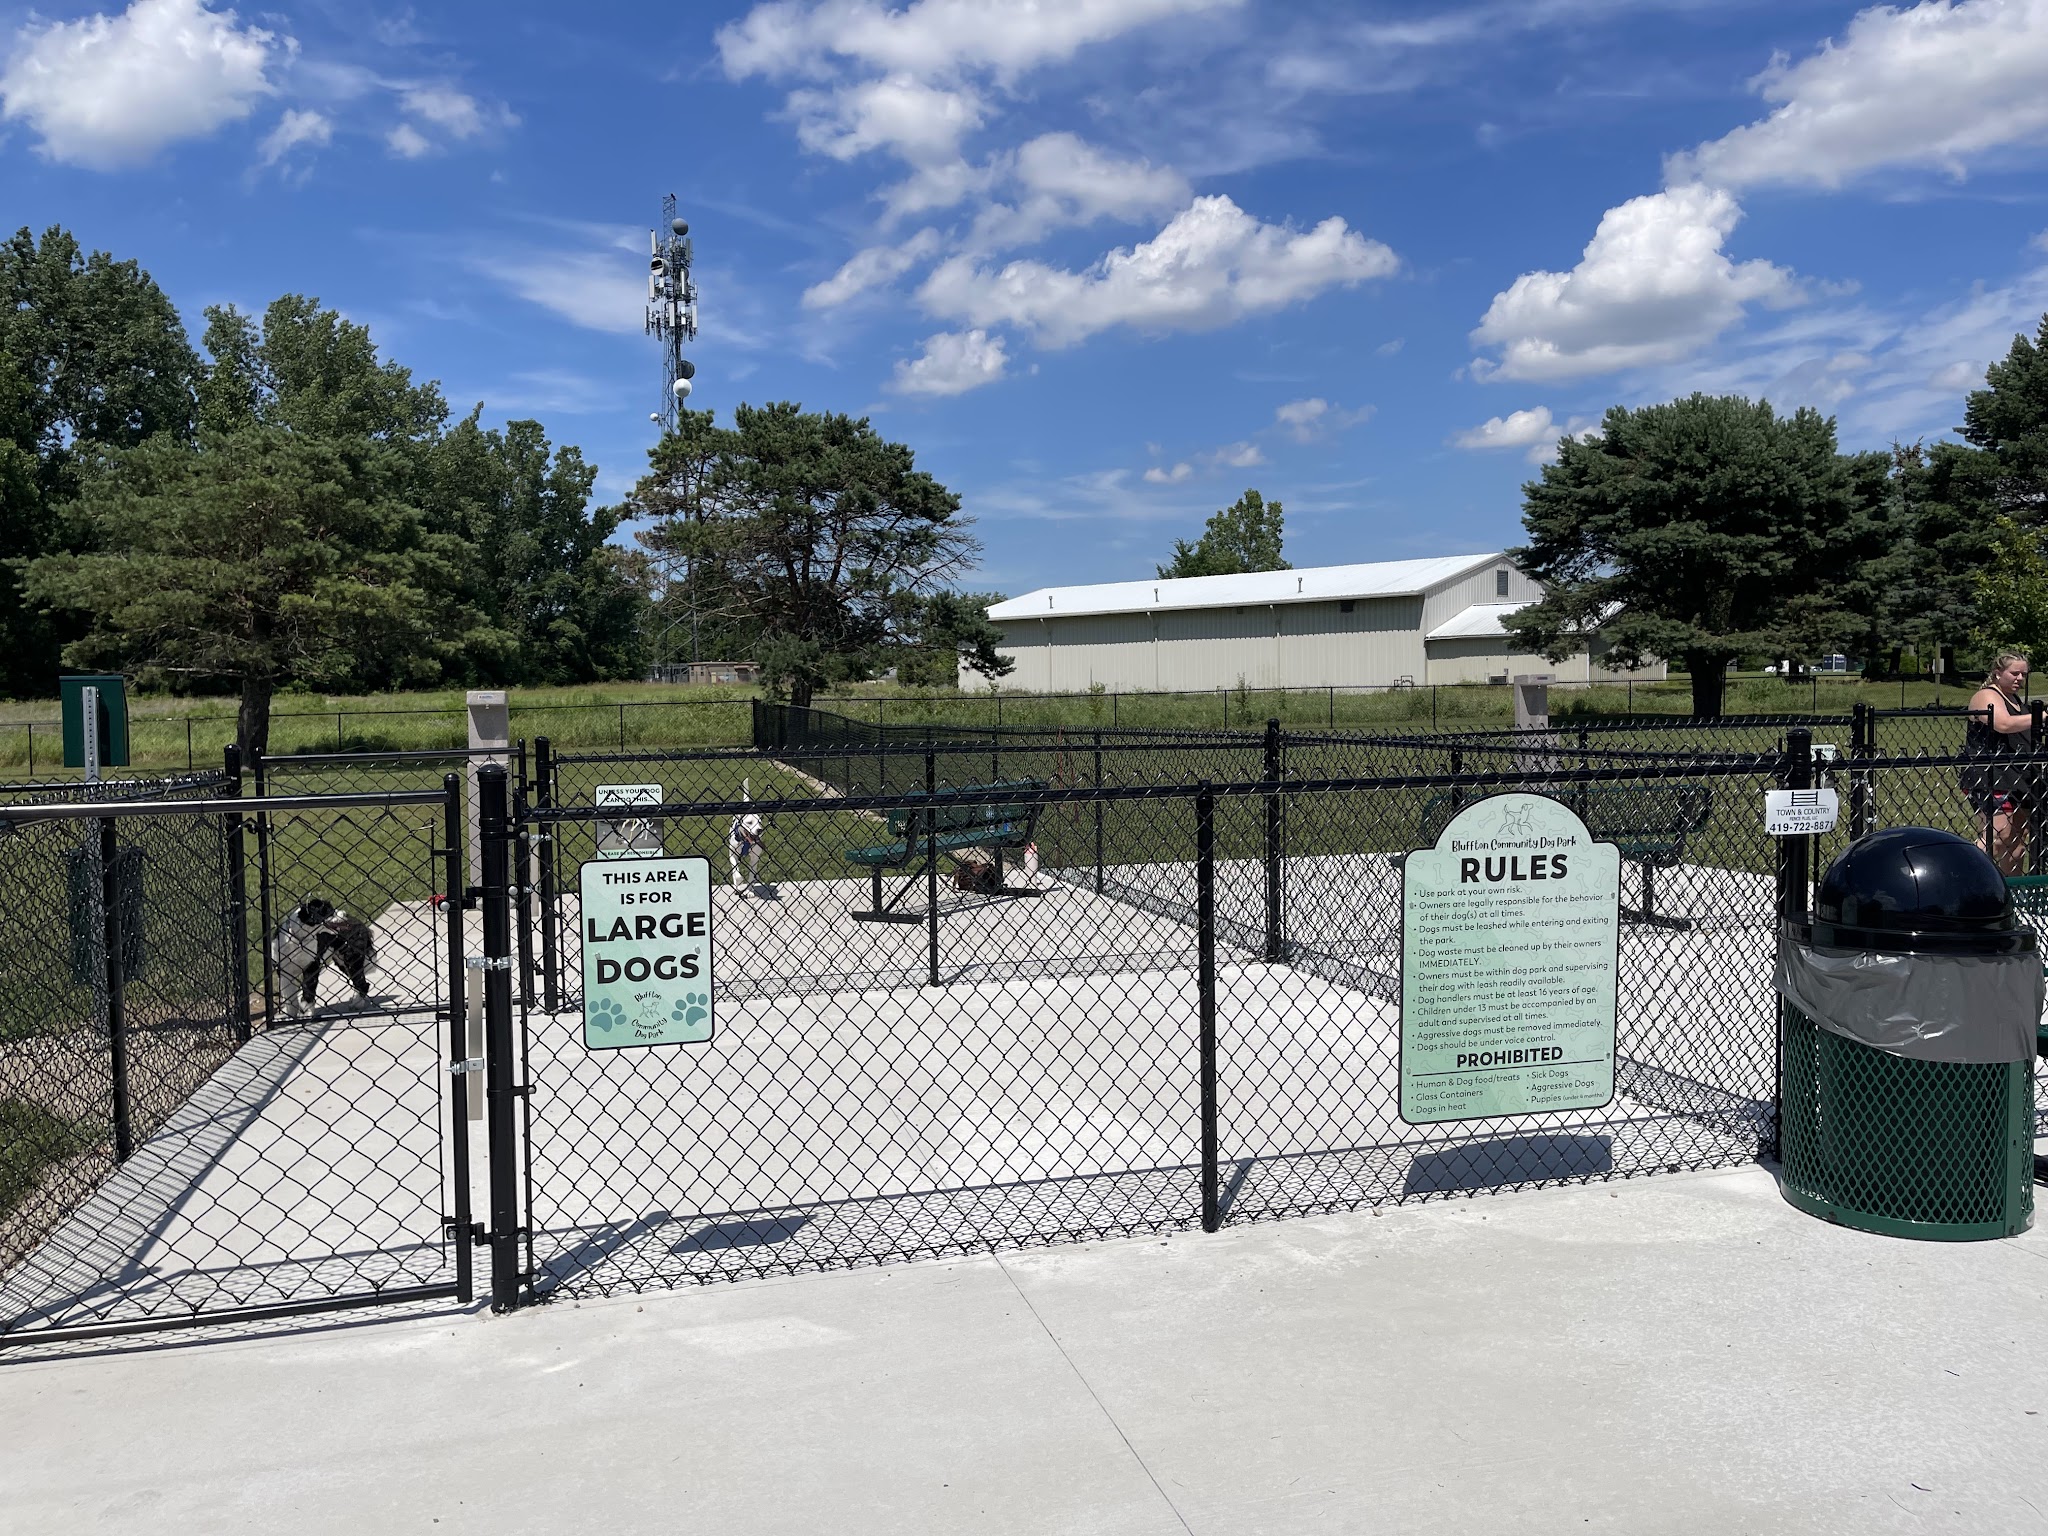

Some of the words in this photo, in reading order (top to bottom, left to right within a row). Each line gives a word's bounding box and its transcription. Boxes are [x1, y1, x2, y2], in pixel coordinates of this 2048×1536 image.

[1804, 807, 1830, 816] COUNTRY
[1770, 820, 1834, 832] 419-722-8871
[1452, 840, 1489, 852] Bluffton
[1490, 838, 1539, 851] Community
[1540, 836, 1555, 849] Dog
[1556, 836, 1577, 848] Park
[1461, 854, 1568, 884] RULES
[603, 872, 640, 884] THIS
[645, 870, 688, 883] AREA
[620, 893, 635, 905] IS
[640, 892, 672, 904] FOR
[1420, 890, 1435, 898] Use
[1438, 888, 1455, 898] park
[1468, 888, 1486, 896] your
[1506, 886, 1522, 894] risk.
[1419, 902, 1450, 910] Owners
[1468, 898, 1494, 908] legally
[1496, 896, 1540, 906] responsible
[1542, 896, 1552, 904] for
[1570, 894, 1604, 902] behavior
[1420, 913, 1428, 921] of
[1431, 912, 1450, 921] their
[1452, 910, 1477, 921] dog(s)
[1490, 910, 1500, 918] all
[588, 912, 706, 942] LARGE
[1419, 925, 1440, 934] Dogs
[1442, 924, 1462, 932] must
[1476, 921, 1507, 930] leashed
[1510, 920, 1530, 928] while
[1532, 918, 1564, 928] entering
[1582, 916, 1608, 925] exiting
[1420, 937, 1434, 945] the
[1436, 936, 1456, 946] park.
[1418, 948, 1436, 958] Dog
[1438, 948, 1462, 956] waste
[1464, 946, 1484, 955] must
[1498, 944, 1528, 952] cleaned
[1542, 942, 1552, 951] by
[1554, 941, 1572, 949] their
[597, 953, 700, 984] DOGS
[1419, 958, 1482, 968] IMMEDIATELY.
[1418, 972, 1450, 980] Owners
[1452, 970, 1472, 979] must
[1486, 968, 1510, 976] within
[1512, 967, 1528, 976] dog
[1530, 966, 1546, 975] park
[1548, 964, 1564, 972] and
[1566, 962, 1608, 972] supervising
[1419, 984, 1438, 992] their
[1440, 983, 1456, 992] dog
[1457, 982, 1475, 990] with
[1477, 980, 1498, 988] leash
[1500, 978, 1526, 988] readily
[1528, 976, 1566, 986] available.
[634, 990, 662, 1002] Bluffton
[1418, 996, 1434, 1006] Dog
[1436, 994, 1472, 1003] handlers
[1473, 992, 1494, 1000] must
[1539, 988, 1548, 996] 16
[1549, 988, 1570, 997] years
[1582, 986, 1598, 994] age.
[1418, 1006, 1450, 1016] Children
[1453, 1005, 1476, 1014] under
[1478, 1004, 1486, 1012] 13
[1488, 1003, 1508, 1011] must
[1522, 998, 1574, 1008] accompanied
[1576, 998, 1585, 1006] by
[632, 1018, 668, 1030] Community
[1418, 1018, 1440, 1028] adult
[1442, 1018, 1456, 1026] and
[1458, 1014, 1501, 1026] supervised
[1514, 1013, 1523, 1021] all
[1525, 1012, 1548, 1020] times.
[634, 1029, 648, 1040] Dog
[648, 1028, 664, 1039] Park
[1417, 1030, 1460, 1040] Aggressive
[1462, 1029, 1482, 1038] dogs
[1484, 1026, 1504, 1034] must
[1518, 1022, 1552, 1032] removed
[1554, 1018, 1602, 1029] immediately.
[1418, 1043, 1438, 1052] Dogs
[1440, 1041, 1466, 1050] should
[1480, 1038, 1502, 1047] under
[1504, 1036, 1524, 1044] voice
[1526, 1034, 1556, 1042] control.
[1456, 1046, 1563, 1068] PROHIBITED
[1416, 1080, 1446, 1088] Human
[1456, 1078, 1473, 1086] Dog
[1475, 1074, 1520, 1084] food/treats
[1532, 1071, 1546, 1079] Sick
[1549, 1070, 1568, 1078] Dogs
[1531, 1082, 1572, 1092] Aggressive
[1574, 1080, 1594, 1088] Dogs
[1416, 1093, 1438, 1101] Glass
[1440, 1090, 1484, 1099] Containers
[1531, 1094, 1562, 1104] Puppies
[1416, 1106, 1436, 1114] Dogs
[1448, 1102, 1466, 1111] heat
